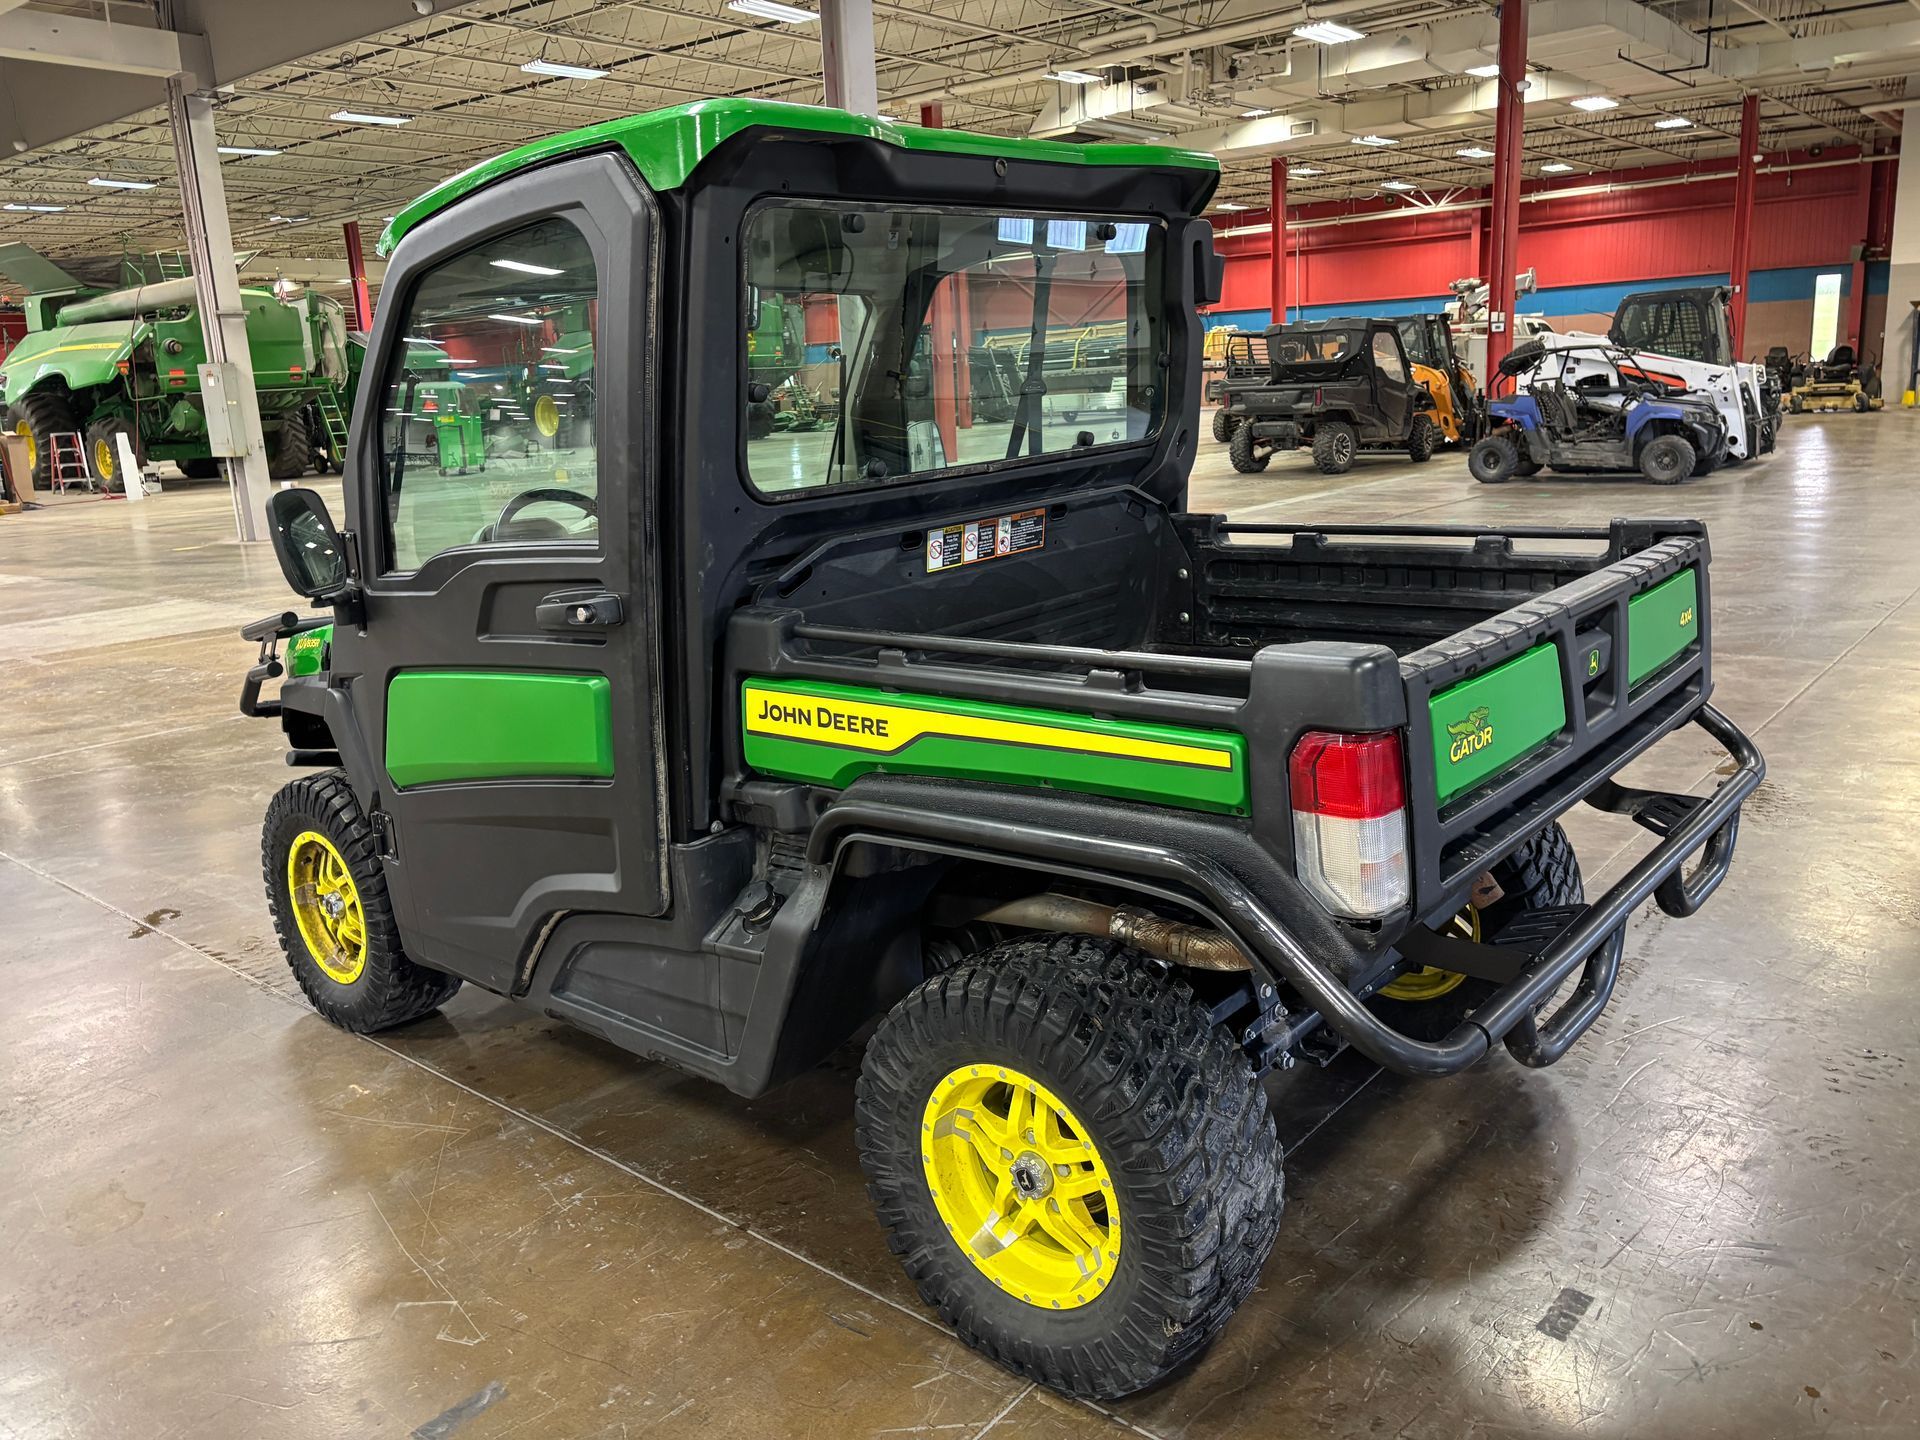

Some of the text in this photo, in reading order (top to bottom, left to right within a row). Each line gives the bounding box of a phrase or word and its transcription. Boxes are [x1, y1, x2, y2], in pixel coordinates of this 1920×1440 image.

[758, 700, 889, 738] JOHN DEERE
[1450, 726, 1493, 762] GATOR
